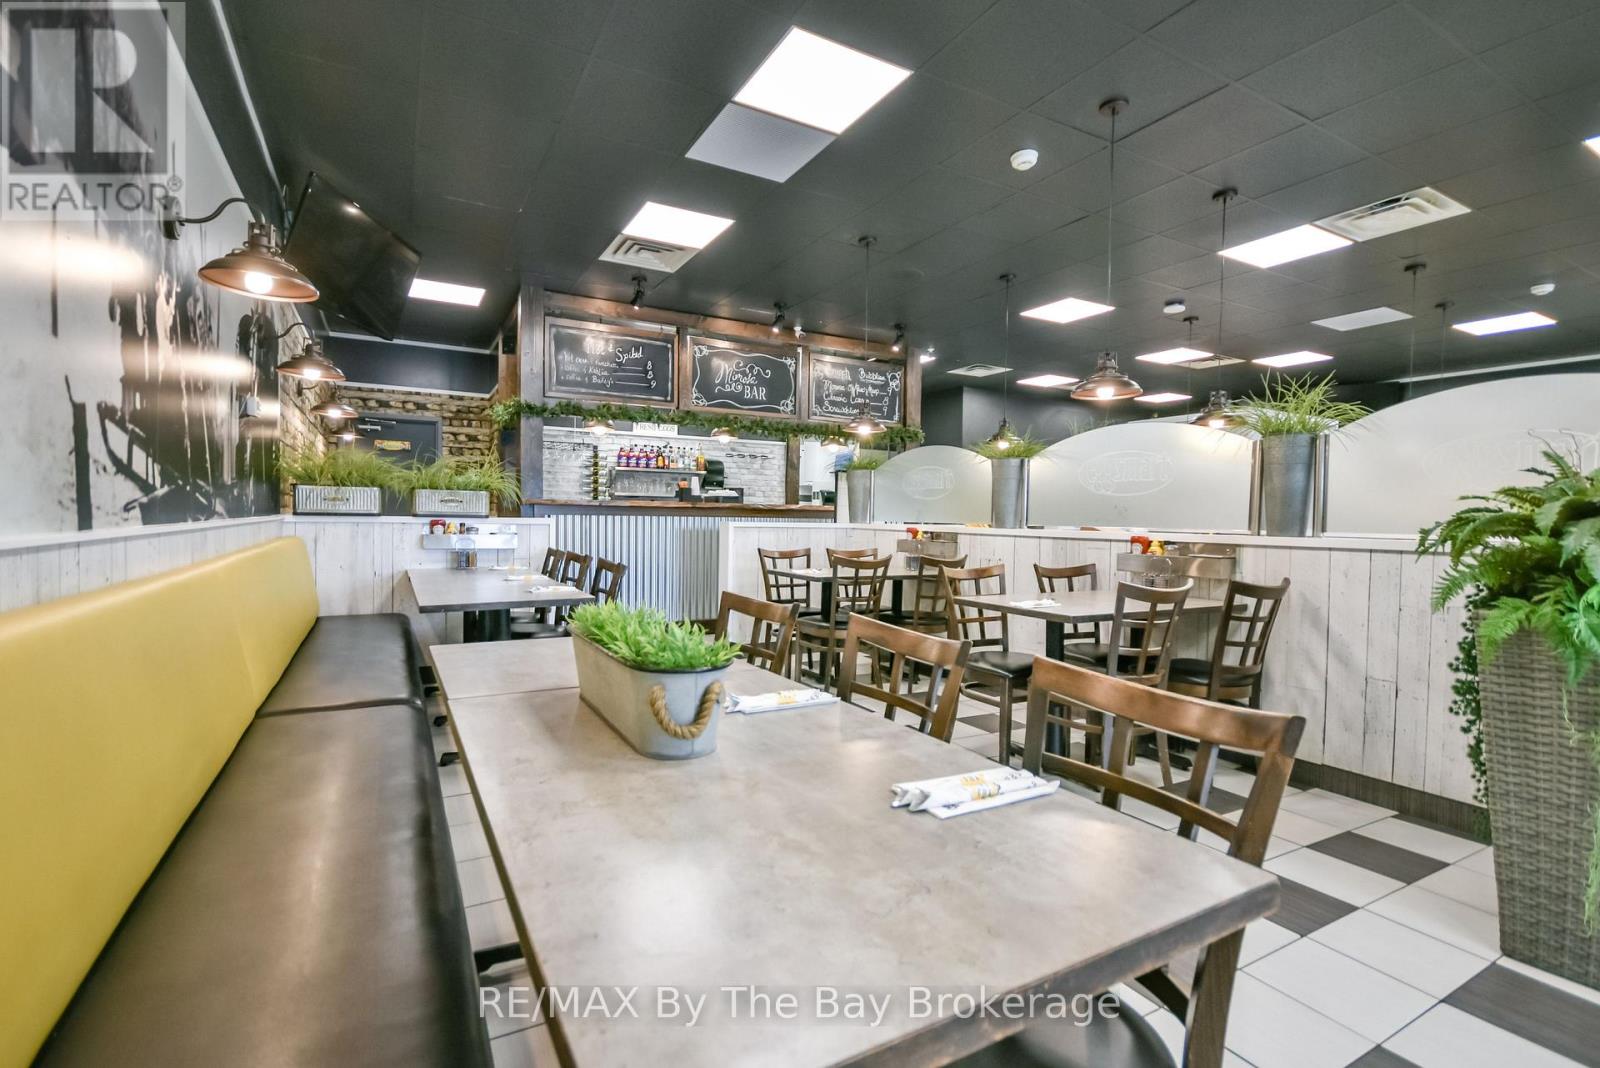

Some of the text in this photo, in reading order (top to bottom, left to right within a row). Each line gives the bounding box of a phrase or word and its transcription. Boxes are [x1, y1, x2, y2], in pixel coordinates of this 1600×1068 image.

[646, 361, 653, 370] 8
[712, 358, 758, 385] Mimosa
[744, 386, 767, 400] BAR
